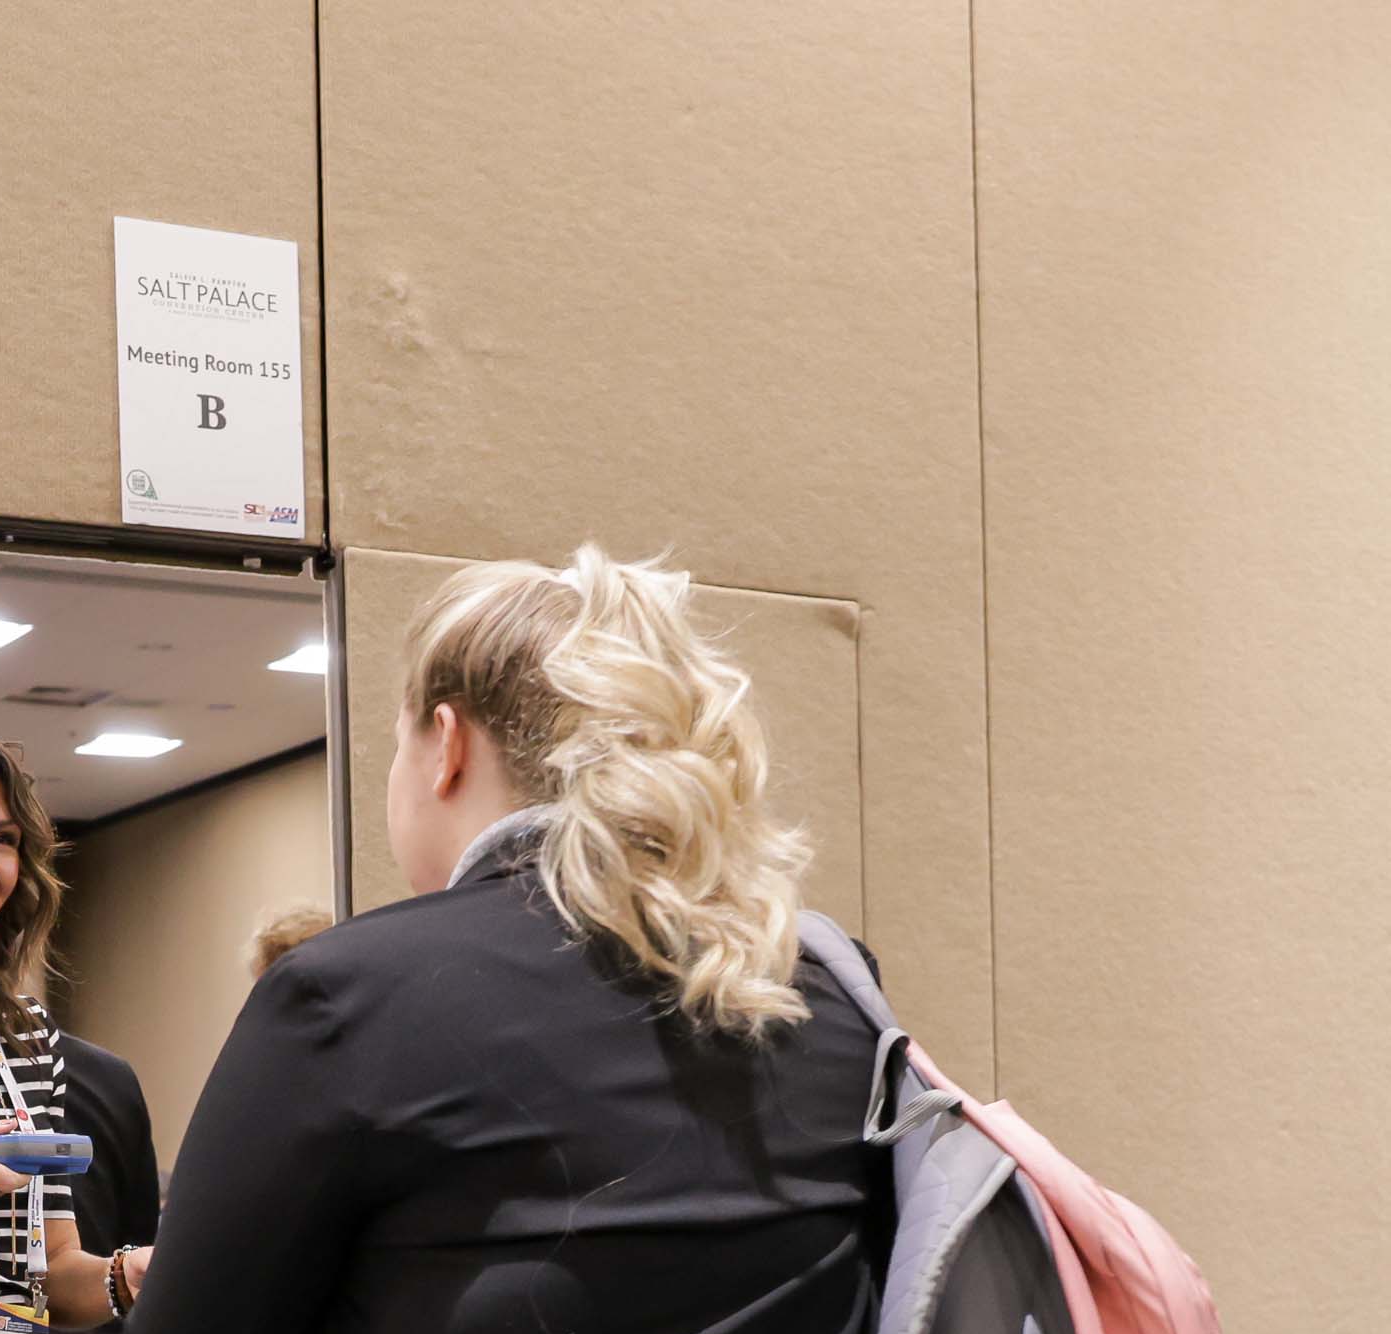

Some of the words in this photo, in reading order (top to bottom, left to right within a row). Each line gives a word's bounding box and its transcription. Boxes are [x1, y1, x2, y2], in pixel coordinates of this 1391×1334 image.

[137, 275, 192, 301] SALT
[197, 284, 279, 313] PALACE
[127, 345, 199, 374] Meeting
[204, 354, 253, 376] Room
[260, 361, 291, 380] 155
[196, 393, 228, 431] B
